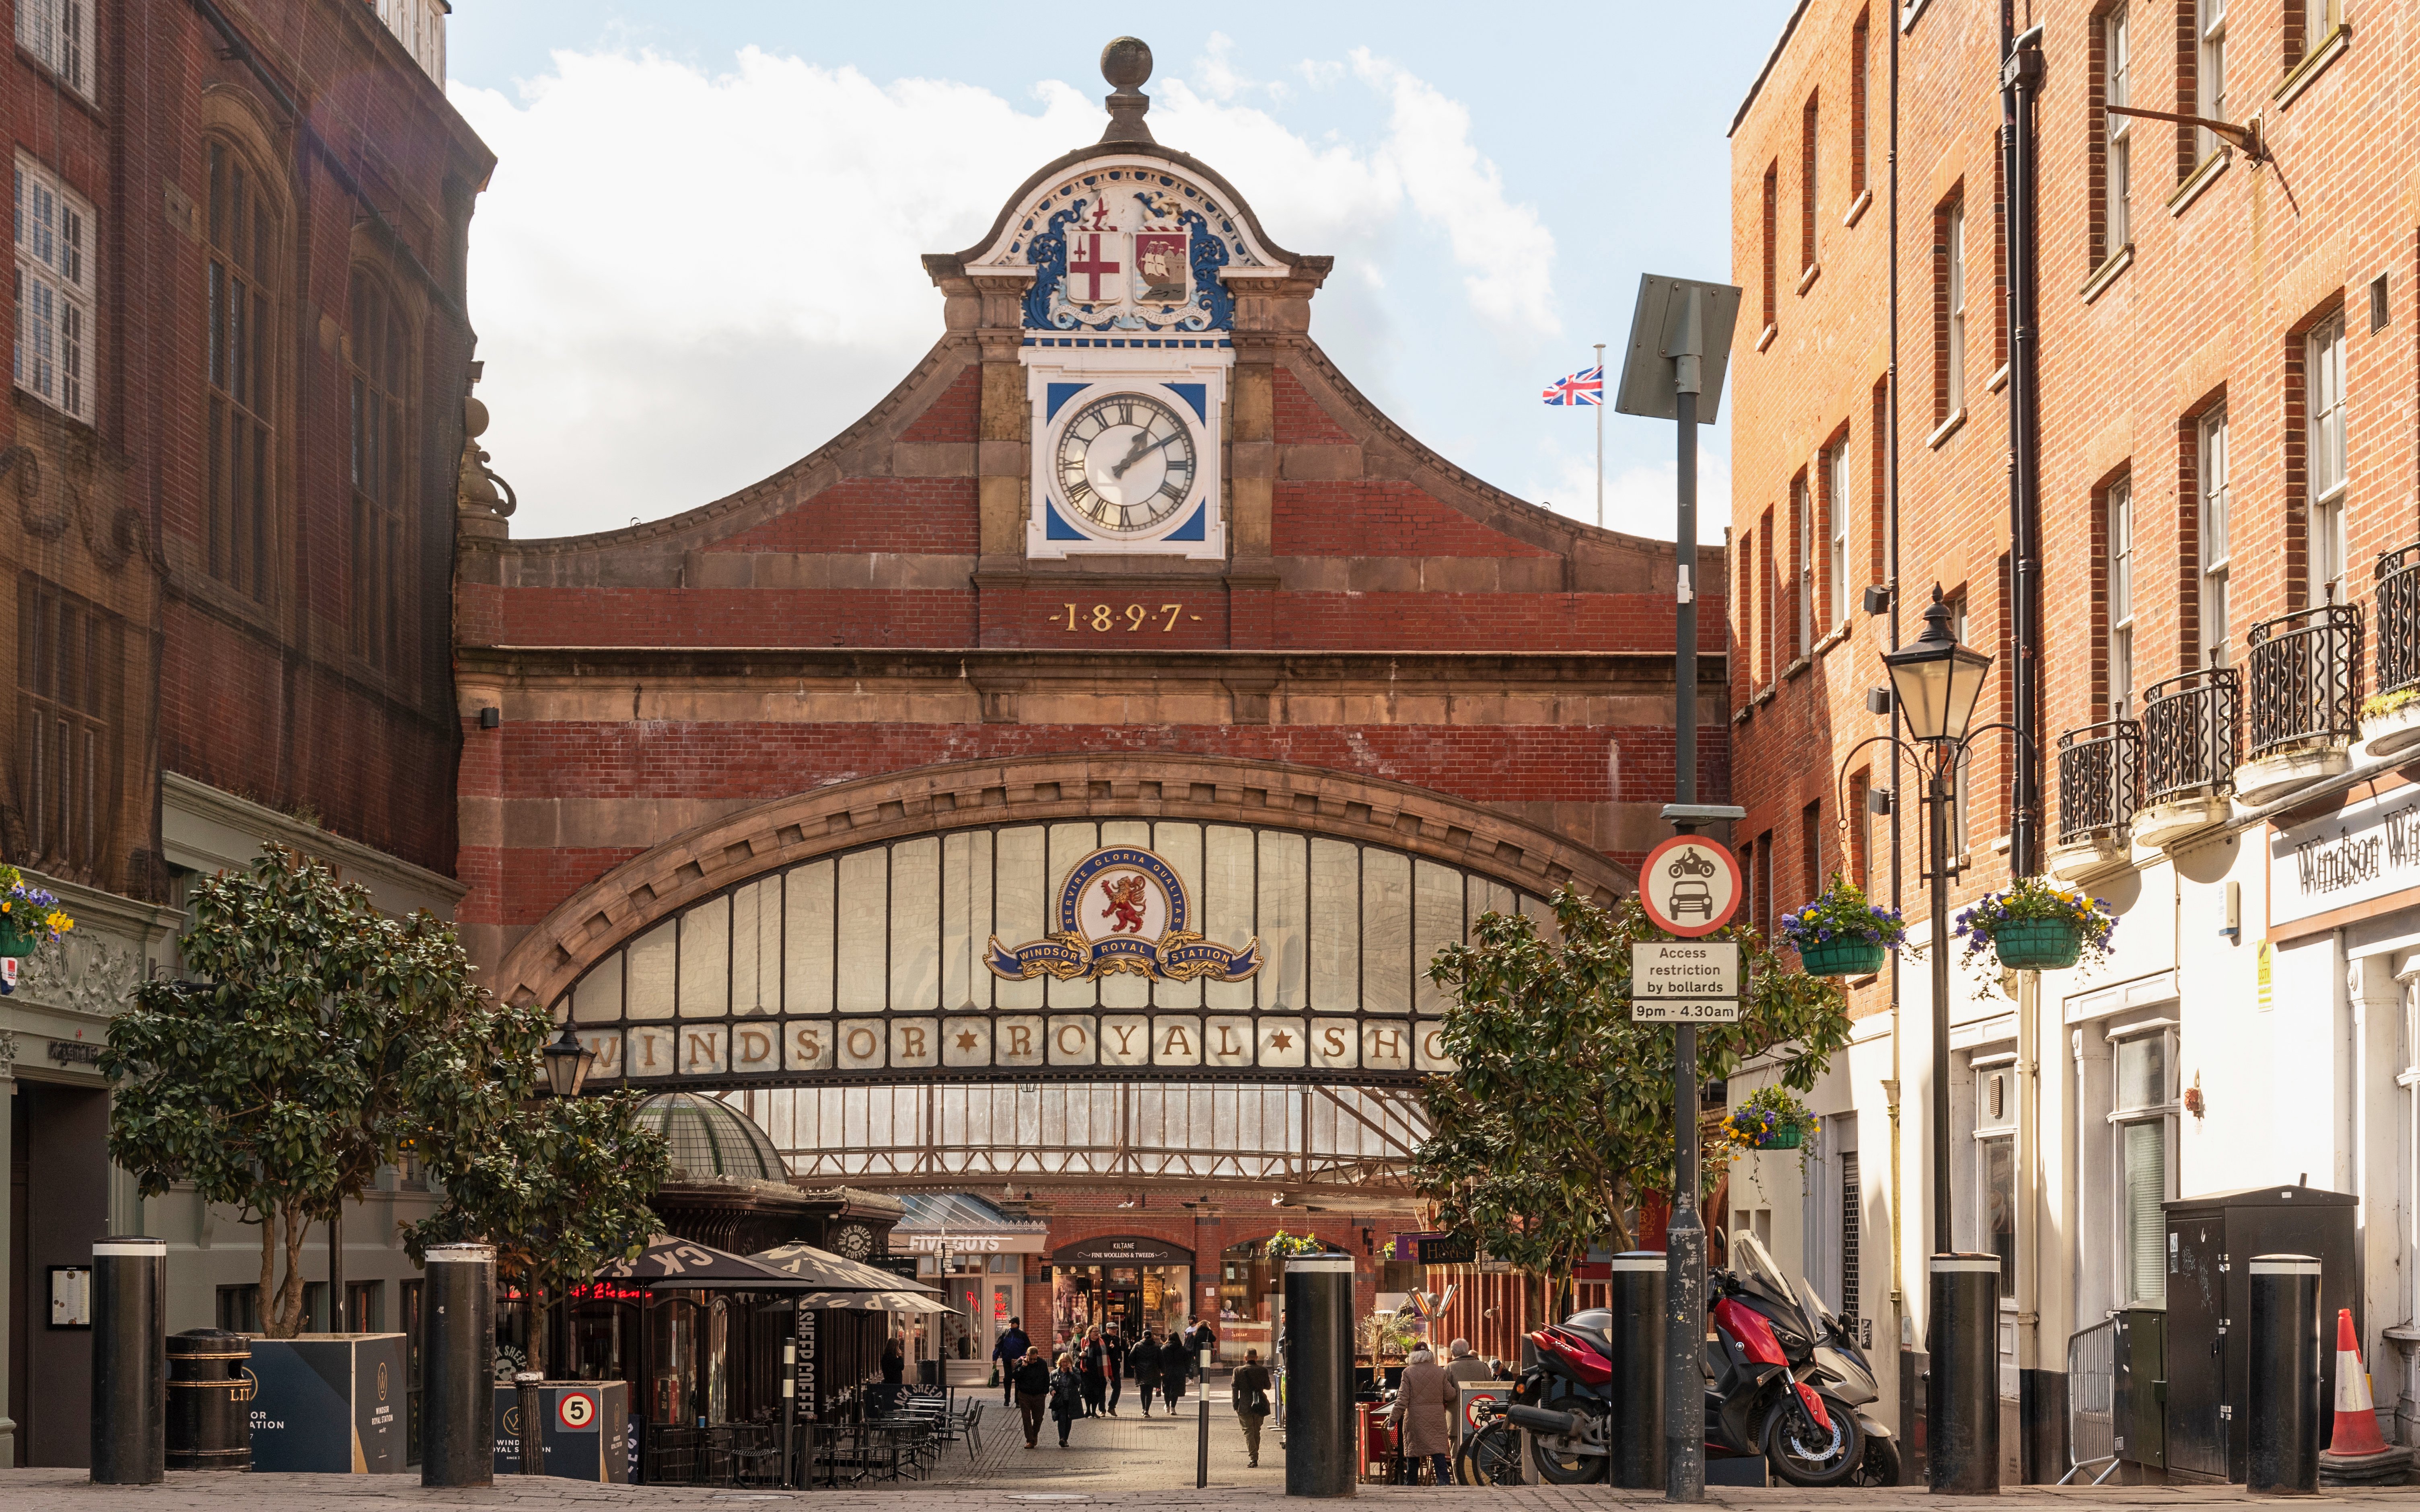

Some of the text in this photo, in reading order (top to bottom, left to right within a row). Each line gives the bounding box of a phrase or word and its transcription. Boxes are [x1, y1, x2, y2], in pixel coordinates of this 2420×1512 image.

[1108, 307, 1124, 316] NOS
[2295, 826, 2383, 898] Windsor
[1066, 853, 1181, 924] SERVIRE GLORIA QUALITAS
[1019, 942, 1231, 963] WINDSOR ROYAL STATION
[1659, 947, 1706, 958] Access
[1650, 964, 1720, 975] restriction
[2258, 968, 2270, 980] CCTV
[1648, 982, 1723, 994] by bollards
[1636, 1005, 1665, 1018] 9pm
[1680, 1005, 1733, 1017] 4.30am
[1007, 1025, 1241, 1056] ROYAL
[1323, 1027, 1449, 1060] SHO
[838, 1225, 871, 1245] BLACK SHEEP
[909, 1235, 999, 1251] FIVE GUYS
[846, 1245, 870, 1259] COFFEE
[1249, 1248, 1286, 1258] JIGSA
[798, 1311, 815, 1359] SHEEP
[504, 1345, 527, 1367] SHEEP
[912, 1384, 943, 1398] SHEEP
[375, 1405, 389, 1415] WINDSOR
[570, 1401, 584, 1420] 5
[250, 1421, 284, 1429] ATION
[372, 1414, 393, 1425] ROYAL STATION
